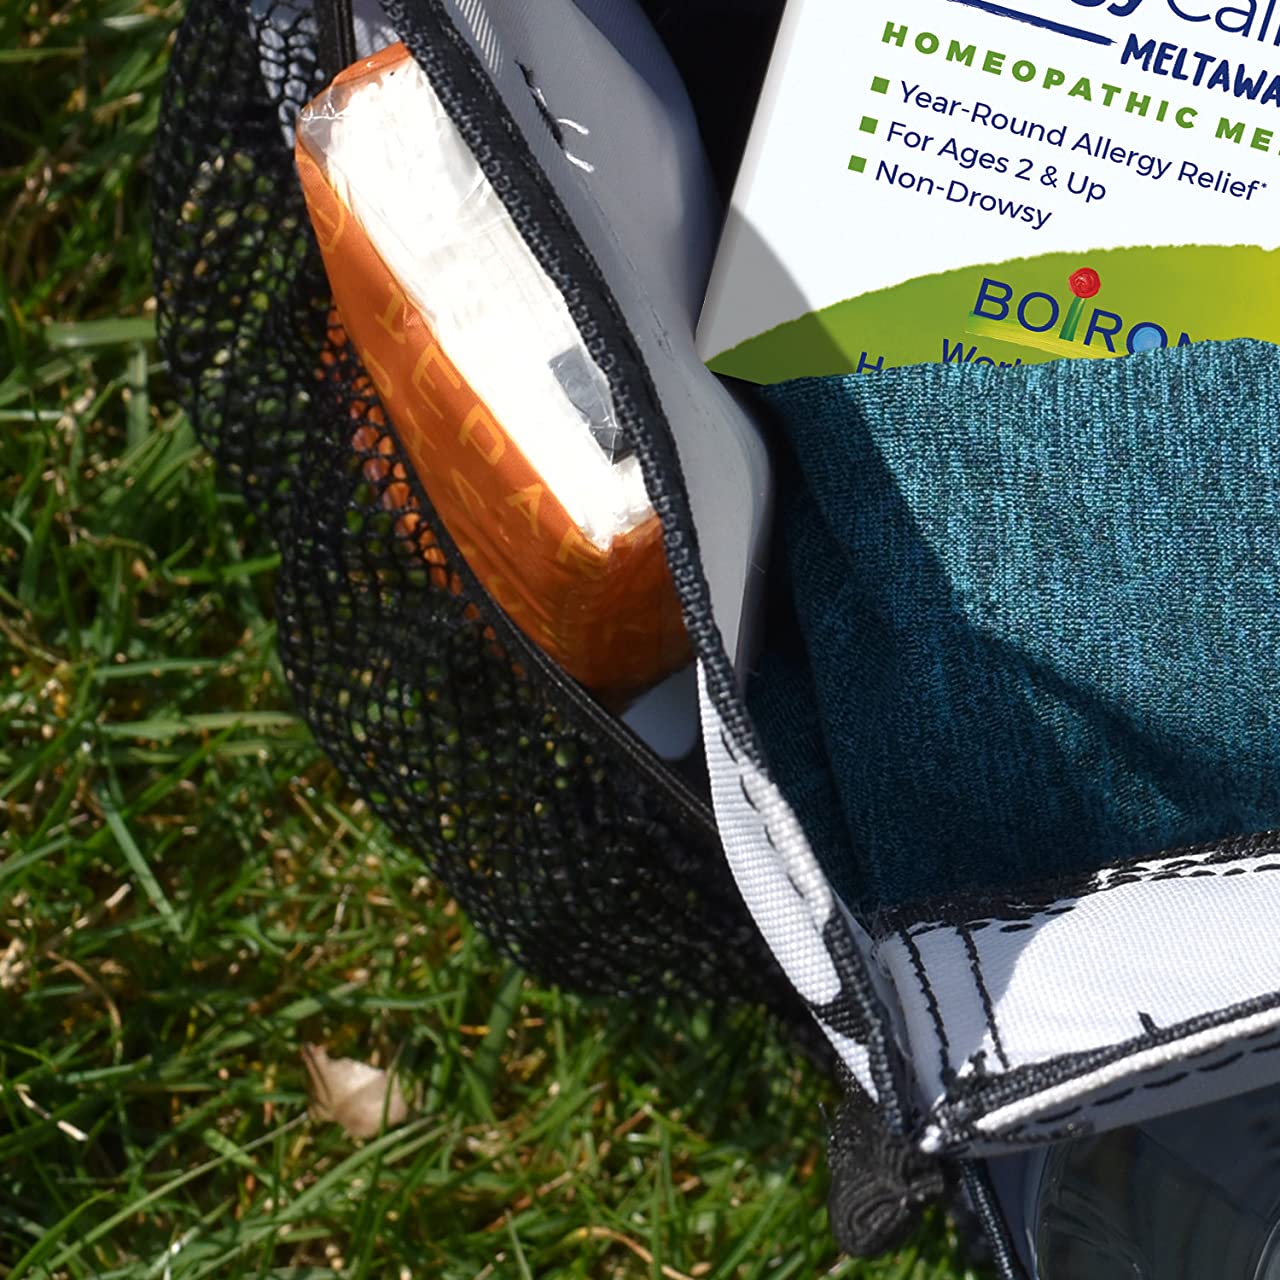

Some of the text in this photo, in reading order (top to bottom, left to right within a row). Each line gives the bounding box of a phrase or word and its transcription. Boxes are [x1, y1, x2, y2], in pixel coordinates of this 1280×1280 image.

[880, 20, 1199, 130] HOMEOPATHIC
[886, 120, 1107, 204] For Ages 2 & Up
[899, 80, 1068, 147] Year-Round
[1071, 132, 1172, 180] Allergy
[875, 160, 1053, 231] Non-Drowsy
[972, 267, 1190, 354] BOIRO
